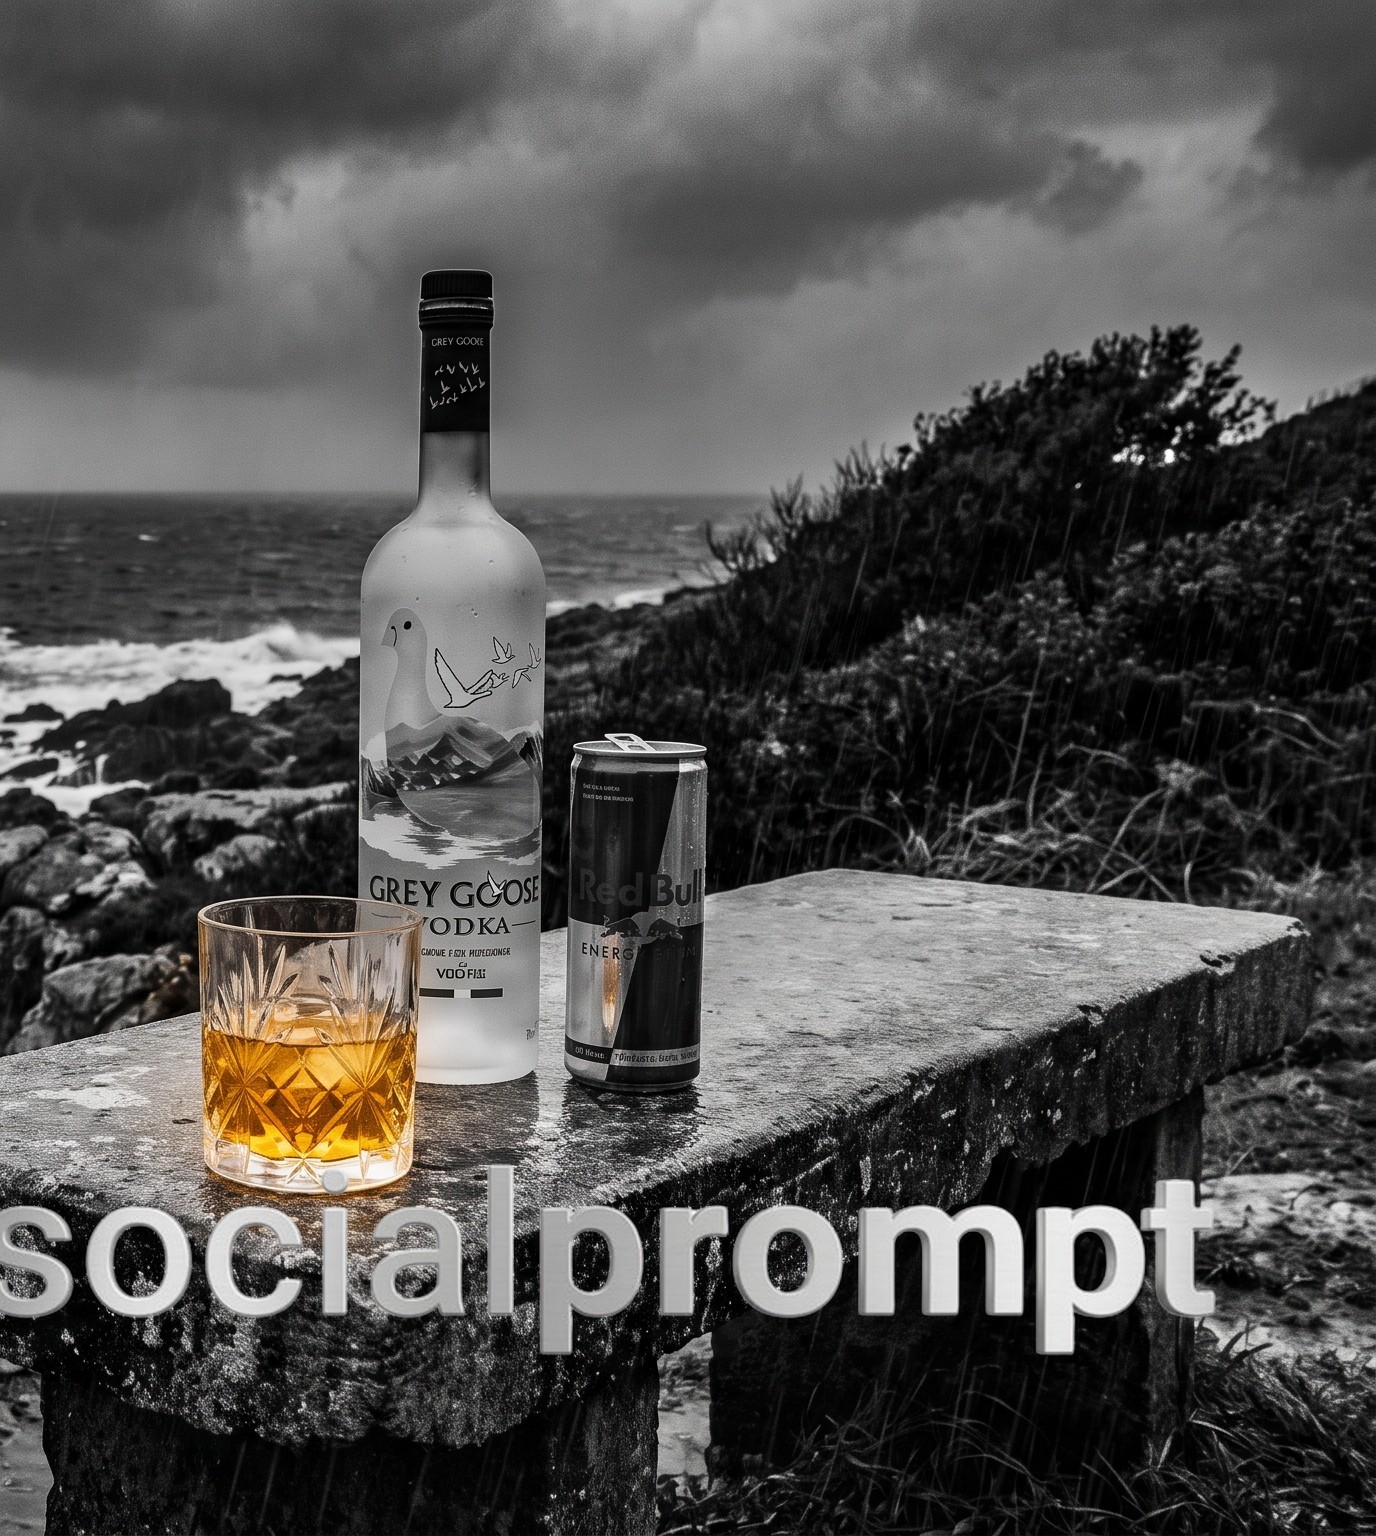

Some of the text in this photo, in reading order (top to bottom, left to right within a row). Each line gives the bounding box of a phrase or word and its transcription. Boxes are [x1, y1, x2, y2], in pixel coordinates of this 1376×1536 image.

[369, 870, 539, 909] GREY GOOSE
[579, 867, 702, 907] Red Bull
